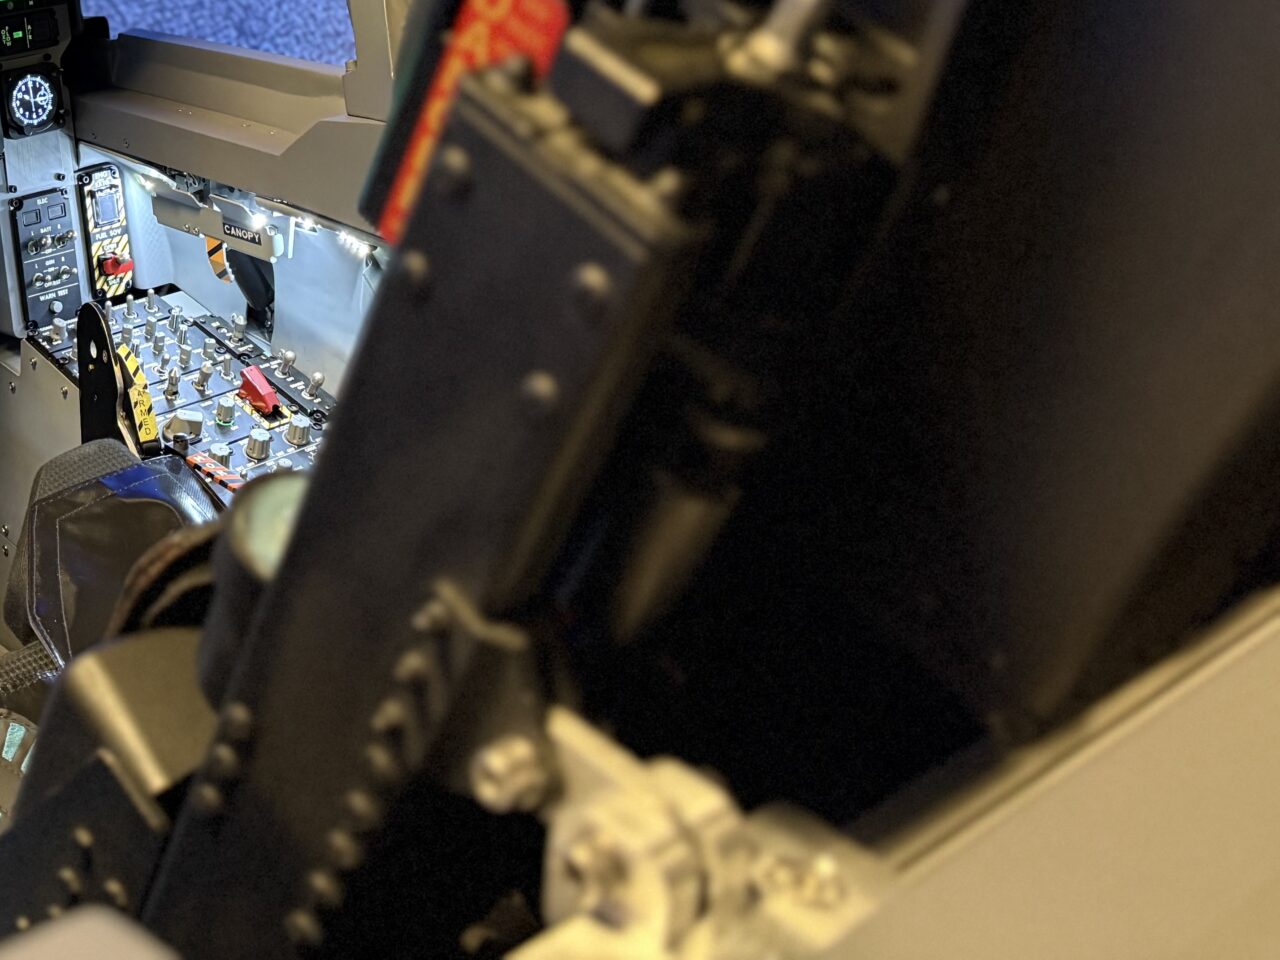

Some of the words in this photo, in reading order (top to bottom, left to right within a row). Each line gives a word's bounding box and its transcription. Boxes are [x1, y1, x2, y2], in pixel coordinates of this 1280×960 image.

[96, 232, 108, 241] FUEL
[110, 227, 122, 237] SOV
[224, 223, 261, 243] CANOPY
[40, 292, 56, 302] WARN
[58, 288, 69, 297] TEST
[137, 388, 152, 436] ARMED
